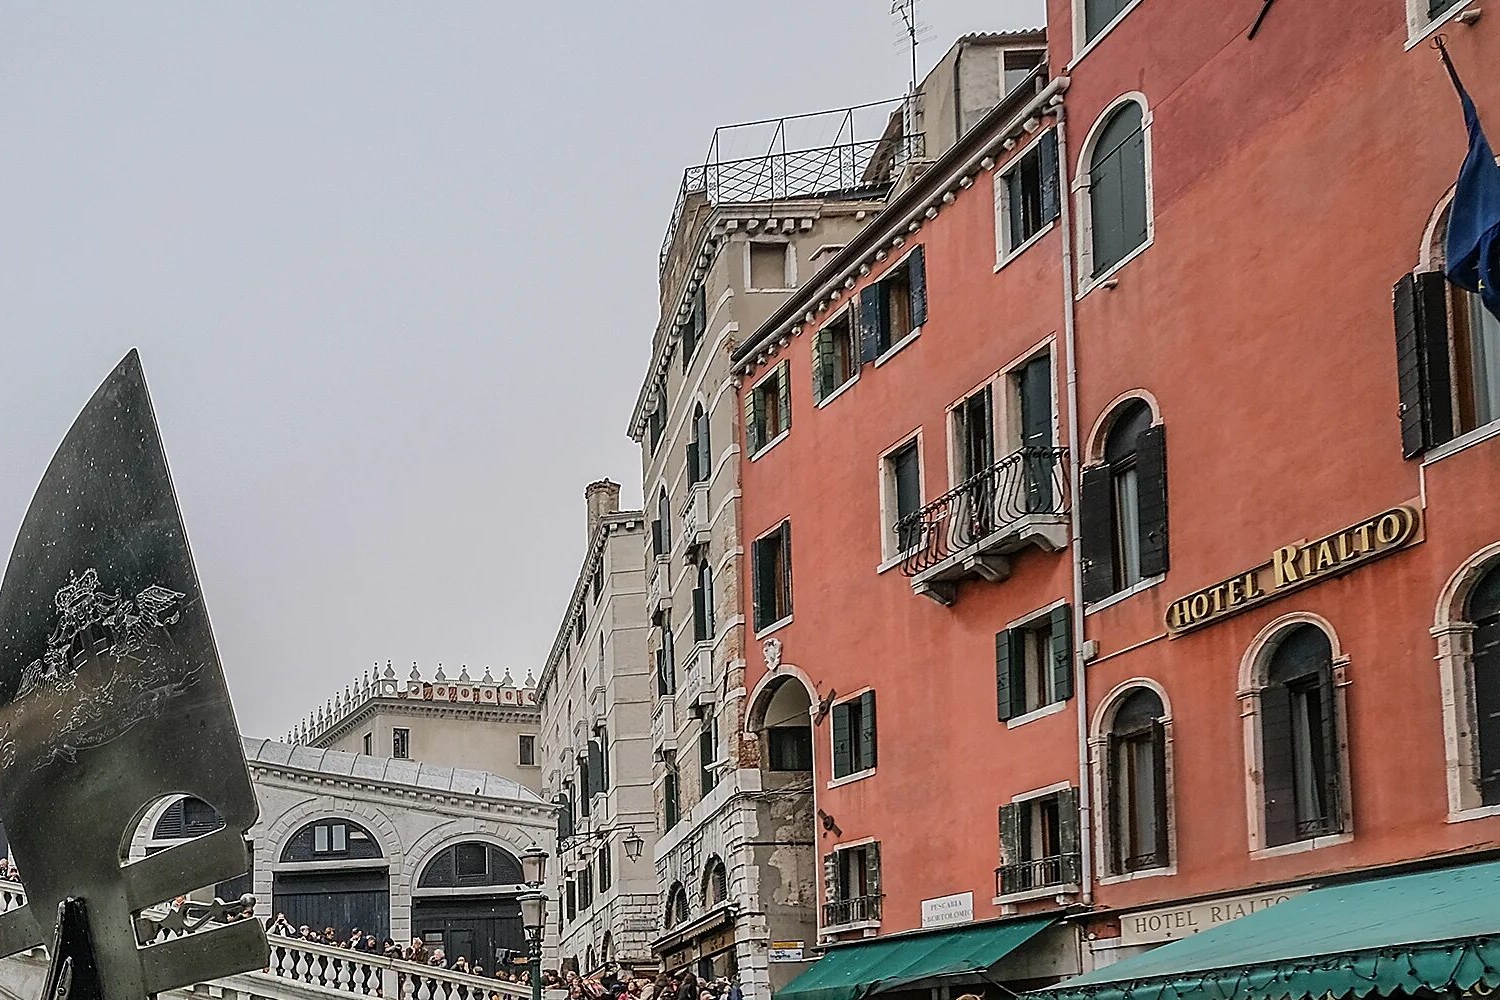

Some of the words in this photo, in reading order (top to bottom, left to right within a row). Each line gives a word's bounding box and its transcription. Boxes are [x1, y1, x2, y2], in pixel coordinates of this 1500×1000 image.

[1173, 573, 1261, 628] HOTEL
[1273, 513, 1401, 588] RIALTO
[1135, 911, 1198, 933] HOTEL
